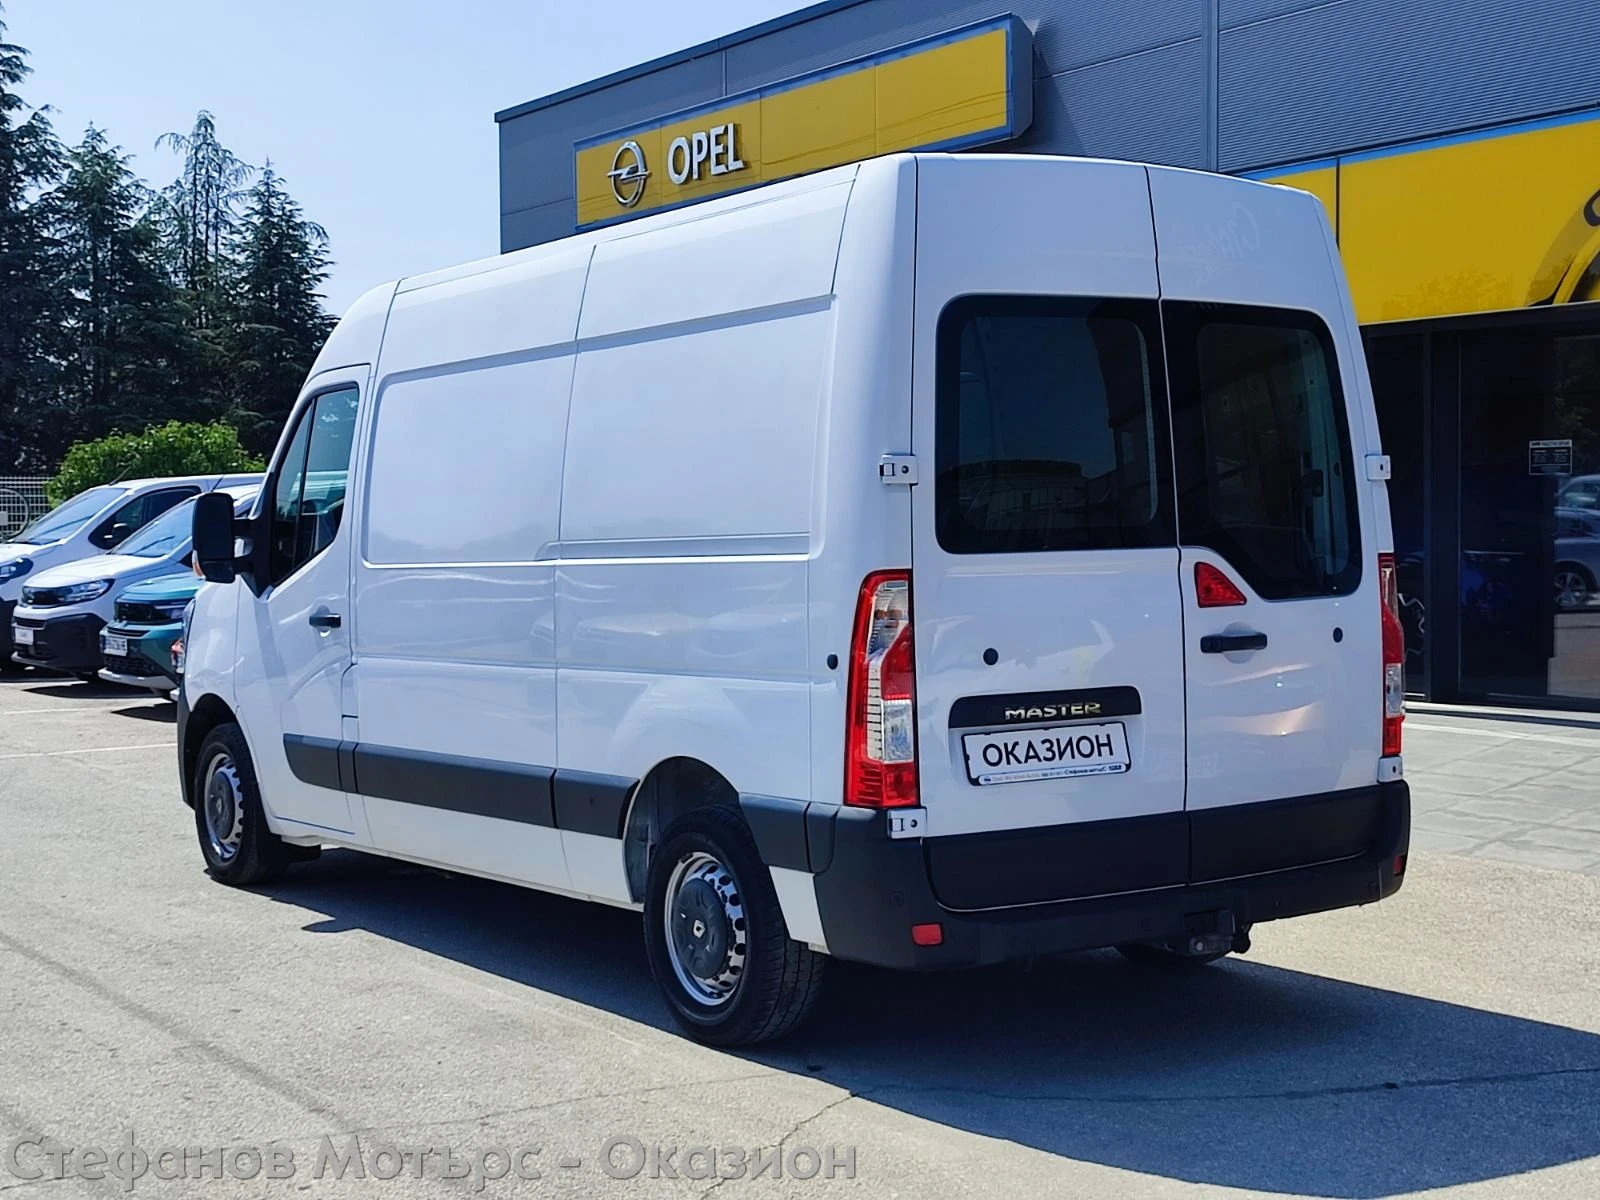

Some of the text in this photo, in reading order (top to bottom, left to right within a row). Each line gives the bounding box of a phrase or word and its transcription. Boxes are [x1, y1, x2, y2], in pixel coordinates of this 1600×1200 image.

[667, 122, 745, 185] OPEL
[1004, 702, 1102, 720] MASTER
[982, 733, 1114, 767] ОКАЗИОН
